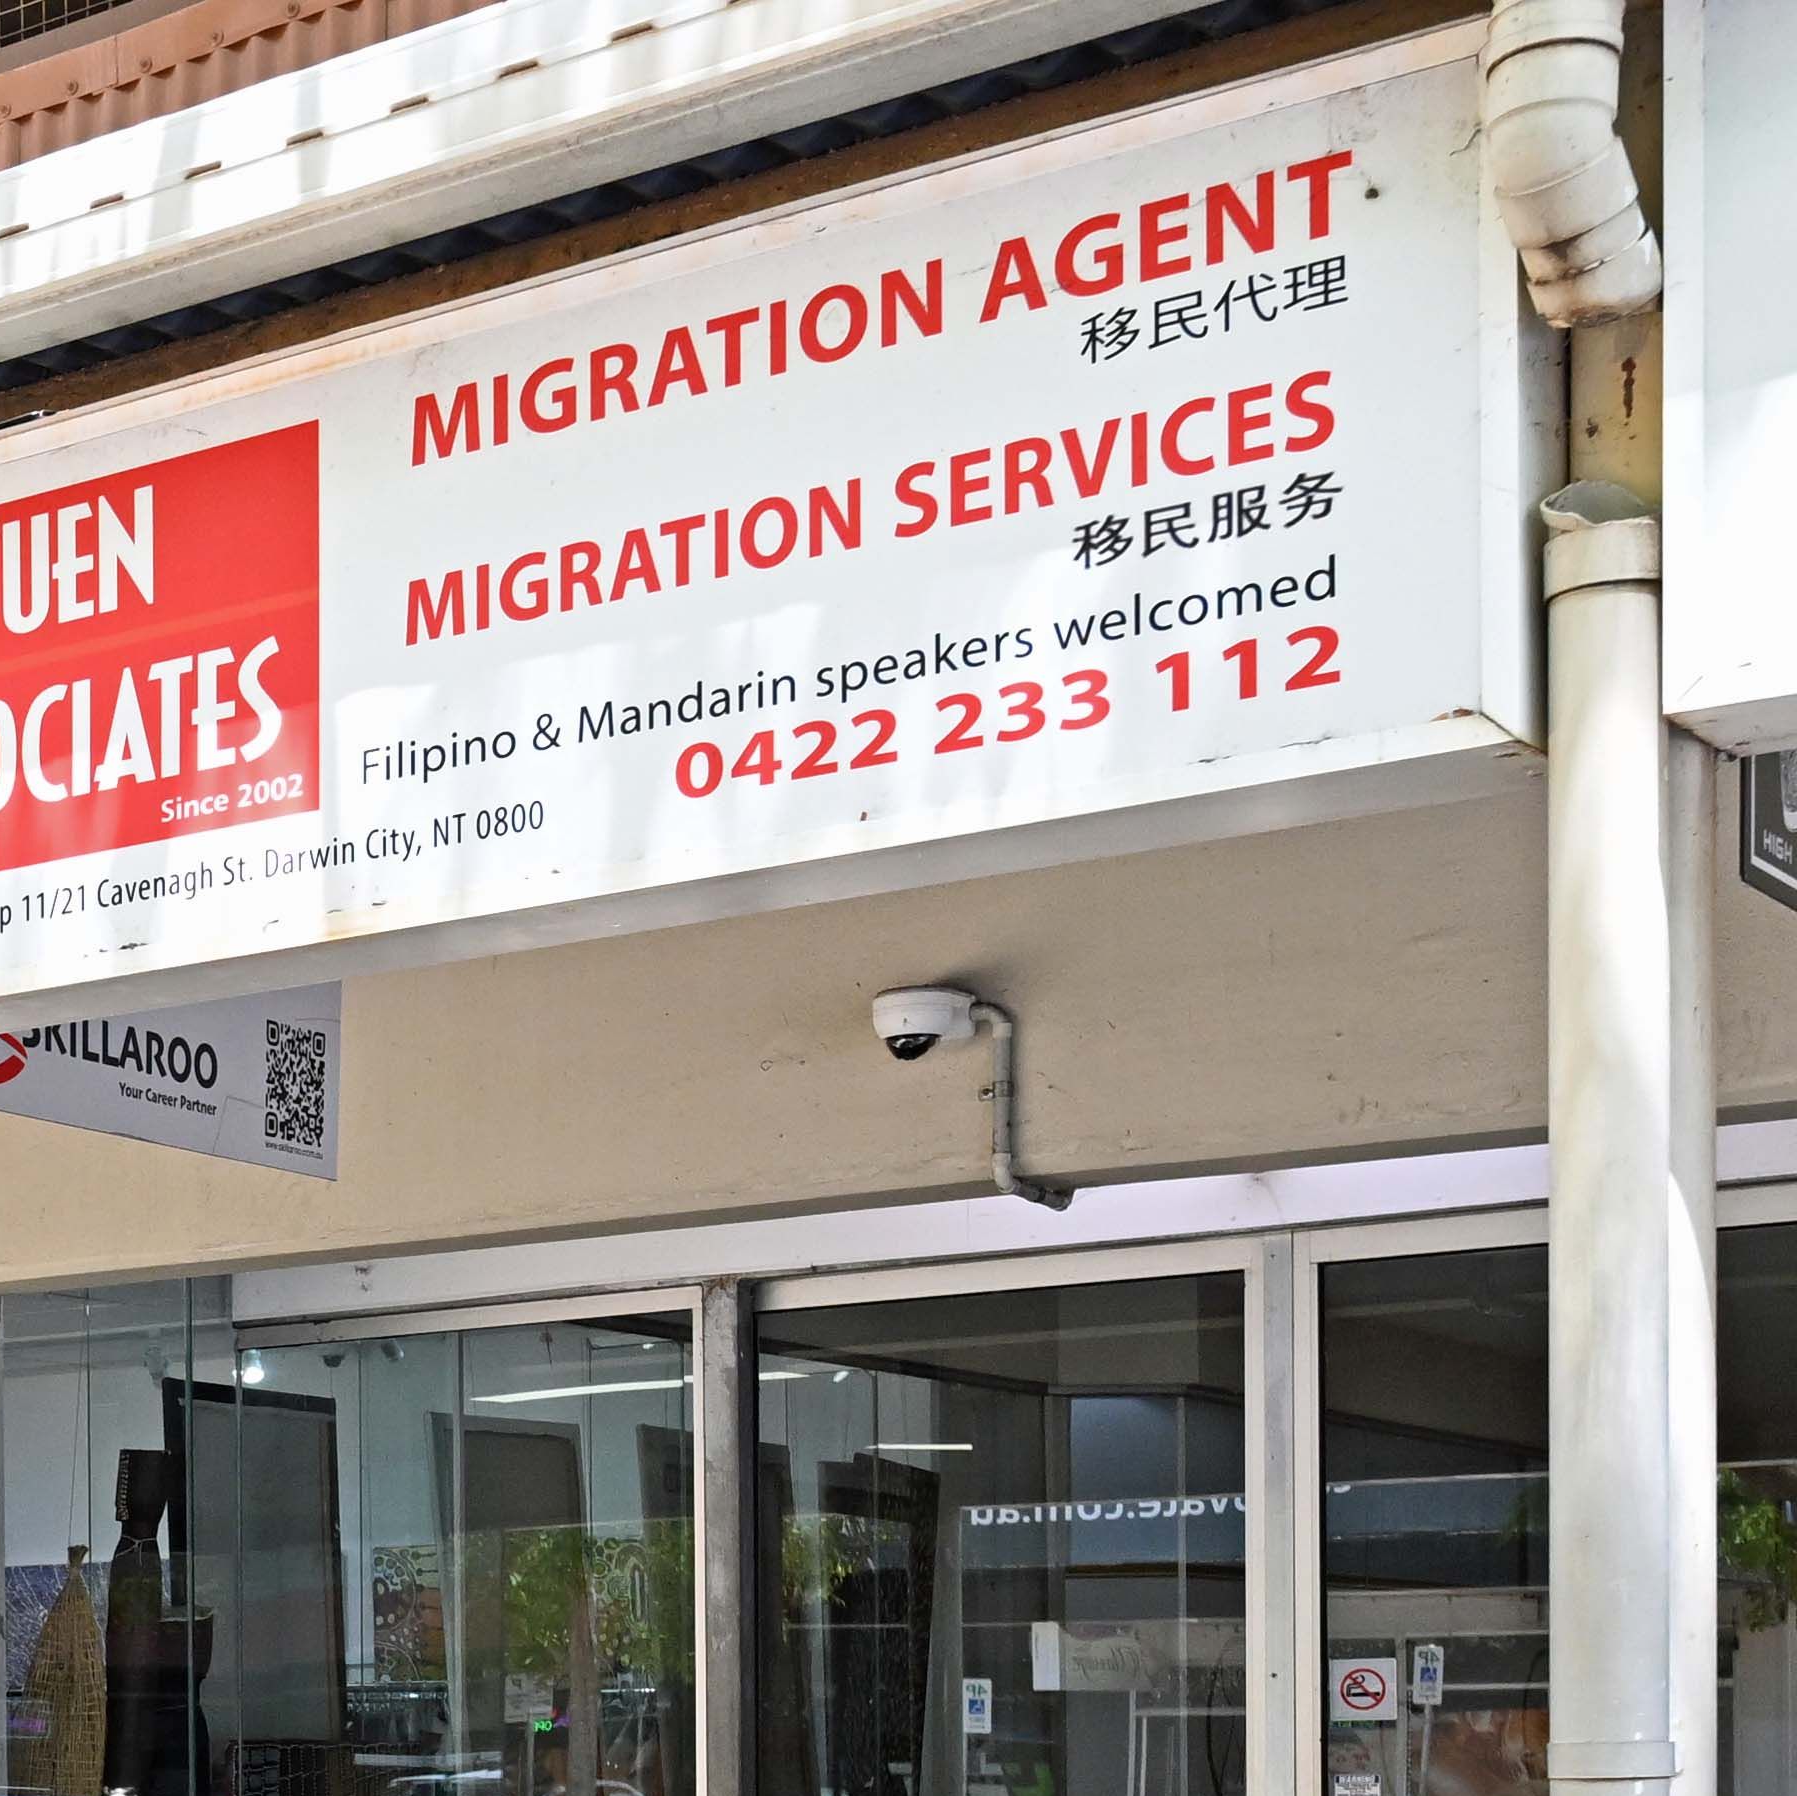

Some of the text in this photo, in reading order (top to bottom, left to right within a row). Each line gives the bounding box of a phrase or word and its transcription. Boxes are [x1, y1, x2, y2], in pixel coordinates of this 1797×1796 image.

[410, 151, 1353, 467] MIGRATION AGENT
[1080, 254, 1350, 365] 移民代理
[405, 370, 1336, 647] MIGRATION SERVICES
[1071, 470, 1345, 571] 移民服务
[362, 556, 1336, 784] Filipino & Mandarin speakers welcomed
[674, 625, 1341, 799] 0422 233 112
[160, 773, 304, 823] Since 2002
[1763, 829, 1793, 862] HIGH
[21, 887, 86, 922] 11/21
[97, 864, 213, 908] Cavenagh
[222, 854, 254, 884] St.
[264, 839, 356, 878] Darwin
[363, 814, 423, 866] City,
[433, 816, 470, 848] NT
[477, 800, 545, 840] 0800
[119, 1081, 217, 1116] Your Career Partner
